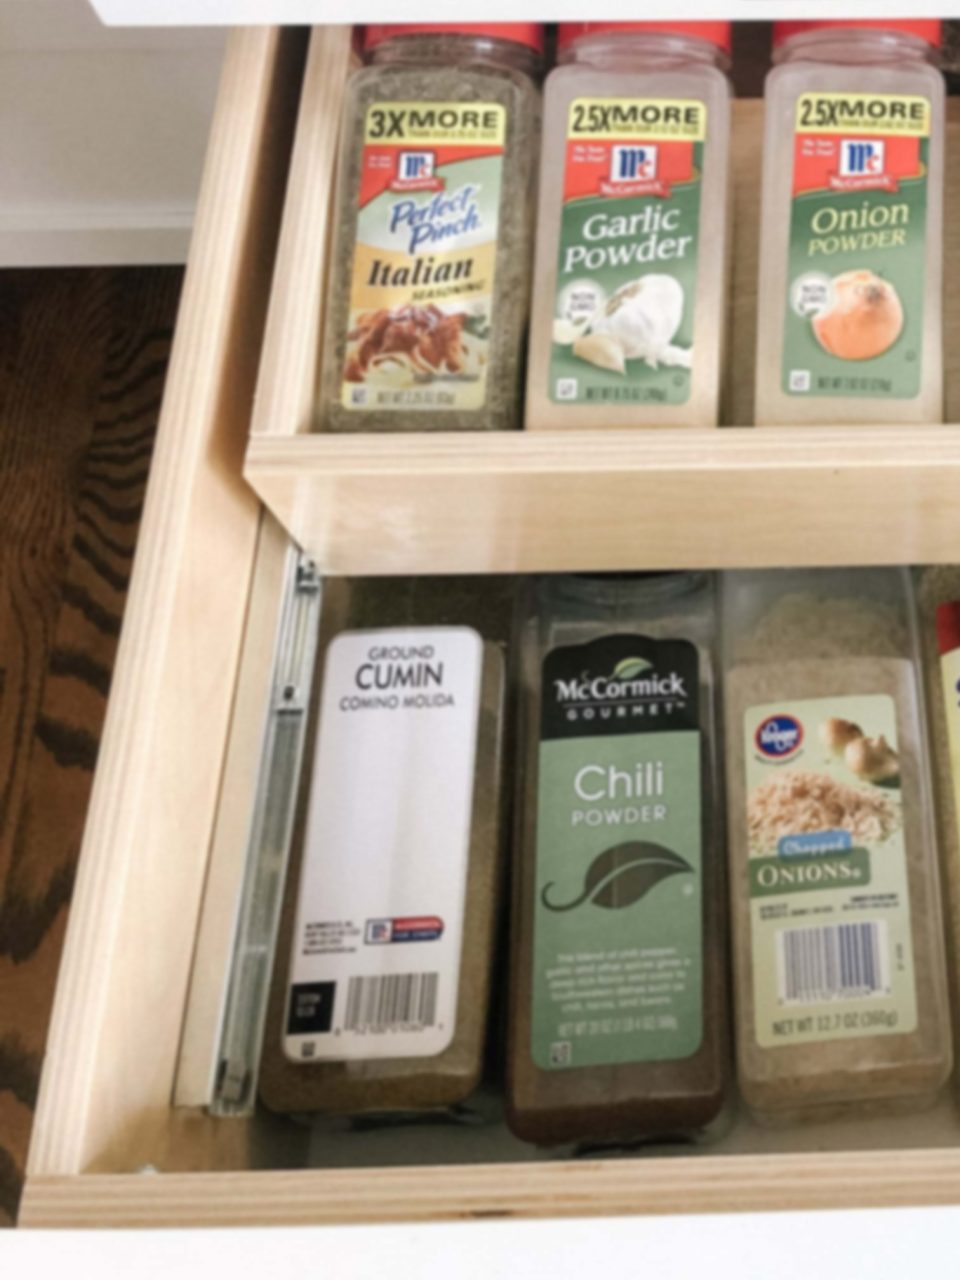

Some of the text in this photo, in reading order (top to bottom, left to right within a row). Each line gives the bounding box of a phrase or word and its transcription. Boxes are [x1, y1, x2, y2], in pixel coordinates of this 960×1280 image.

[407, 109, 499, 129] MORE
[612, 105, 700, 125] MORE
[839, 100, 925, 121] MORE
[390, 186, 475, 233] Perfect
[582, 204, 682, 242] Garlic
[810, 201, 910, 235] Onion
[409, 202, 478, 255] Pinch
[563, 232, 693, 273] Powder
[807, 228, 907, 258] POWDER
[367, 257, 474, 287] Italian
[368, 644, 436, 662] GROUND
[355, 662, 444, 690] CUMIN
[555, 672, 688, 702] McCormick
[339, 693, 455, 712] COMINO MOLIDA
[573, 761, 664, 801] Chili
[571, 804, 667, 827] POWDER
[782, 837, 846, 856] Chopped
[757, 863, 851, 888] ONIONS
[772, 1019, 795, 1036] NET
[797, 1017, 814, 1032] WT
[843, 1012, 859, 1029] OZ
